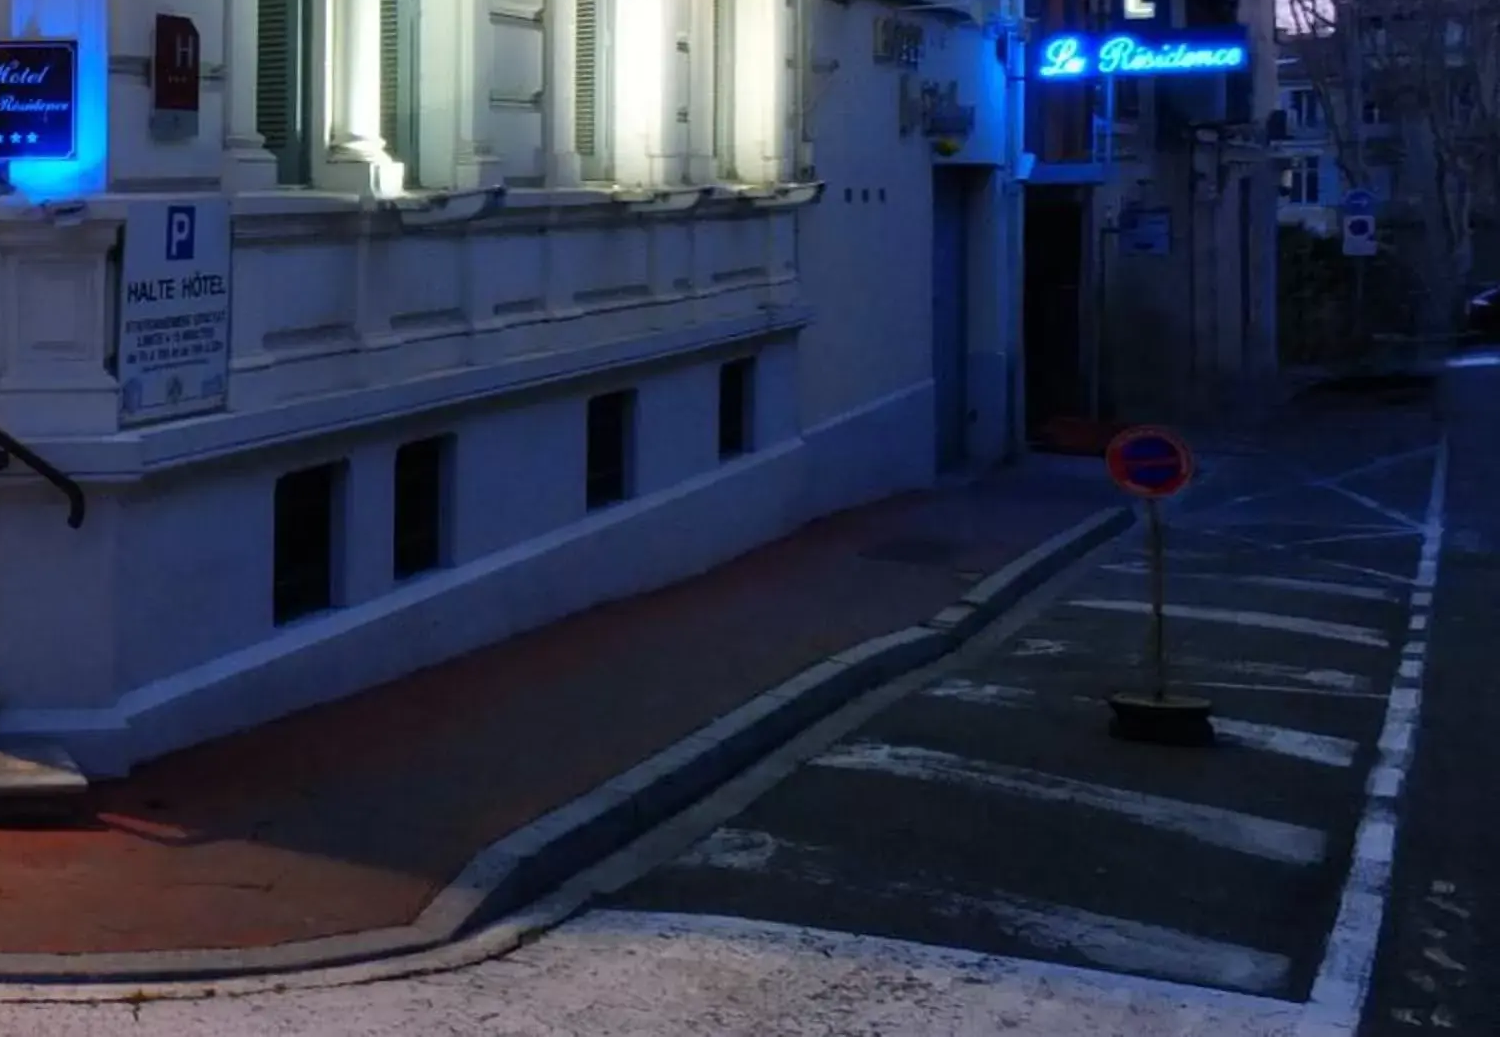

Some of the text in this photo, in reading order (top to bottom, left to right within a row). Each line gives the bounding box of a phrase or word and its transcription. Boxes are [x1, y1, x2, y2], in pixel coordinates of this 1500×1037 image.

[1040, 36, 1086, 76] La
[171, 212, 191, 257] P
[126, 278, 176, 303] HALTE
